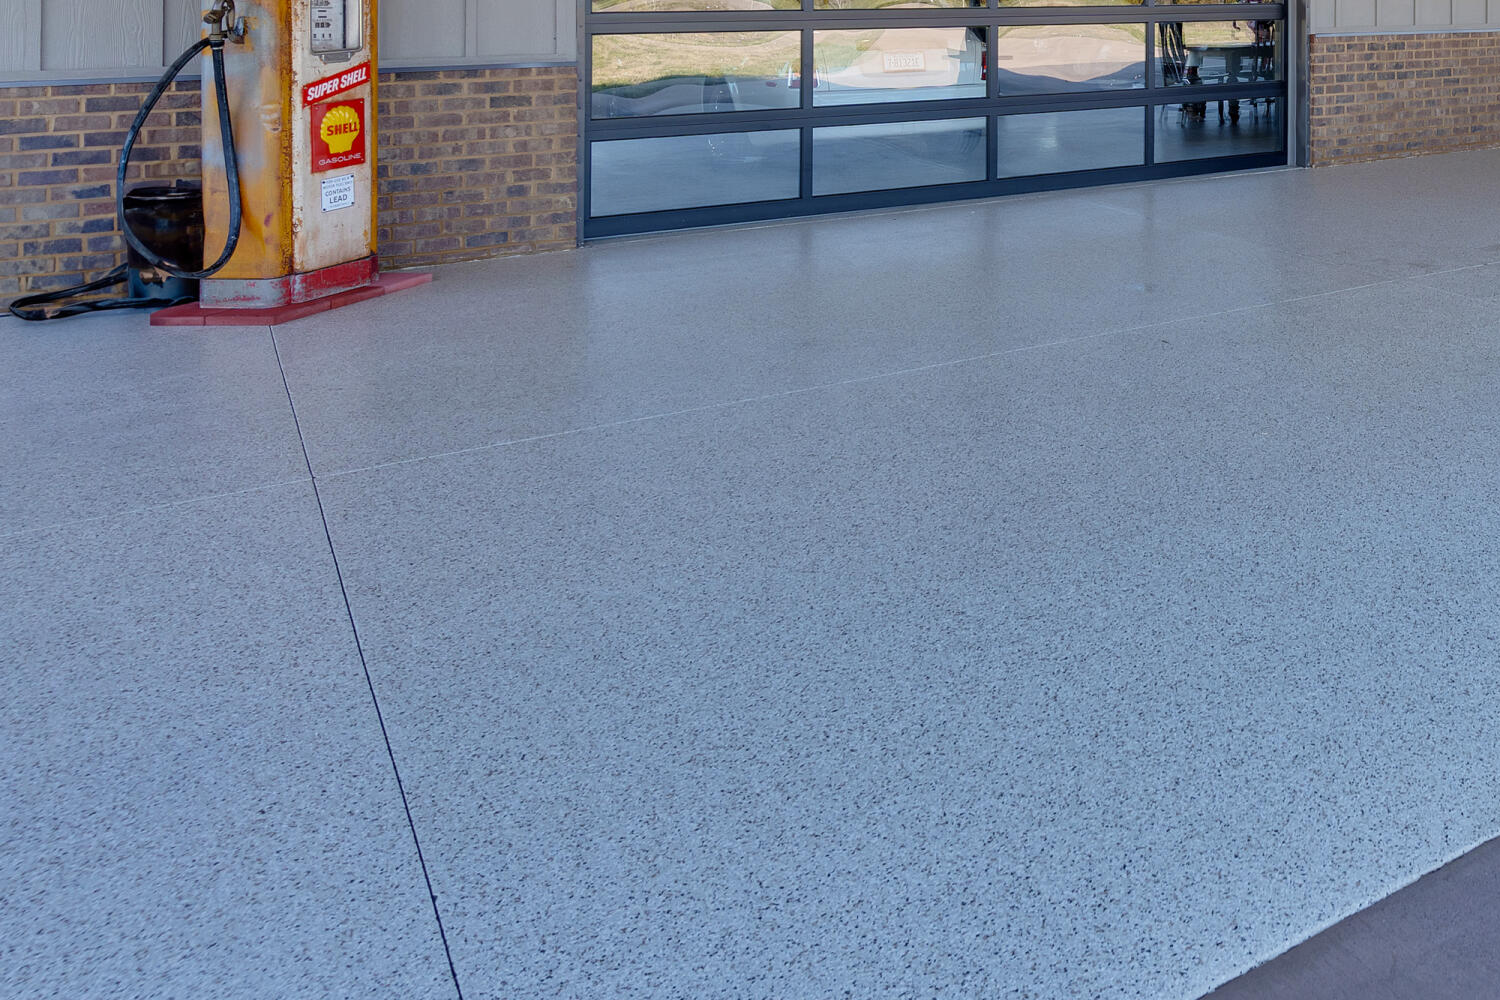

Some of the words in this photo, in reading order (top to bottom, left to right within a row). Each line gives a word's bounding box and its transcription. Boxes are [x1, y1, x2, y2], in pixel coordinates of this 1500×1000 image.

[307, 78, 340, 101] SUPER
[340, 67, 367, 89] SHELL
[326, 121, 359, 136] SHELL
[318, 153, 362, 165] GASOLINE
[325, 186, 352, 197] CONTAINS
[329, 193, 348, 204] LEAD
